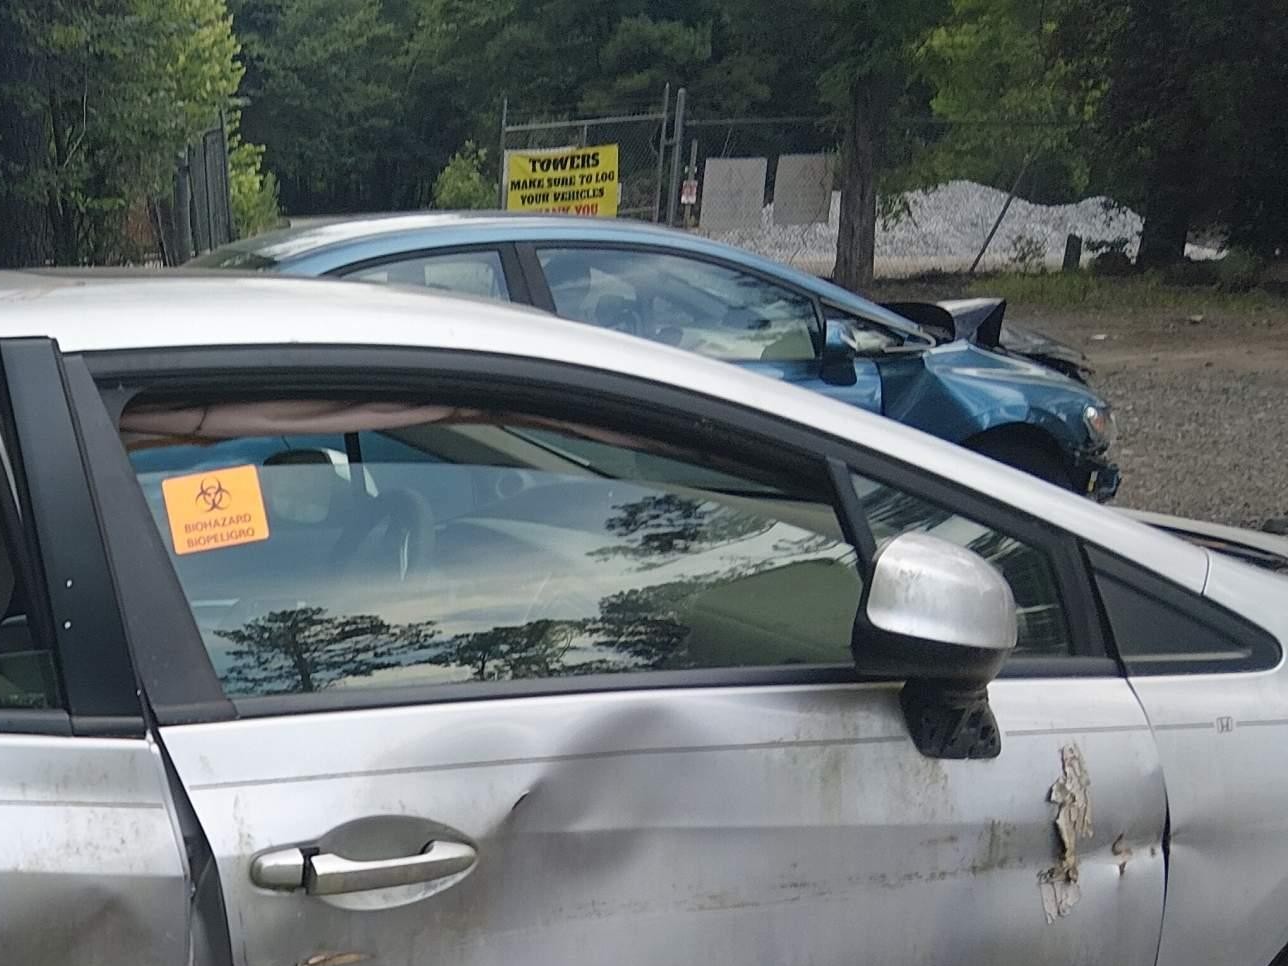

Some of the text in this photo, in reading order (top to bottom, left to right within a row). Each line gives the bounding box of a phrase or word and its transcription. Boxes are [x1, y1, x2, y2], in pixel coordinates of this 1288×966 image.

[529, 152, 600, 173] TOWERS
[510, 171, 615, 191] MAKE SURE TO LOG
[520, 187, 604, 206] YOUR VEHICLES
[574, 202, 599, 217] YOU
[184, 513, 252, 534] BIOHAZARD
[186, 527, 256, 549] BIOPELIGRO
